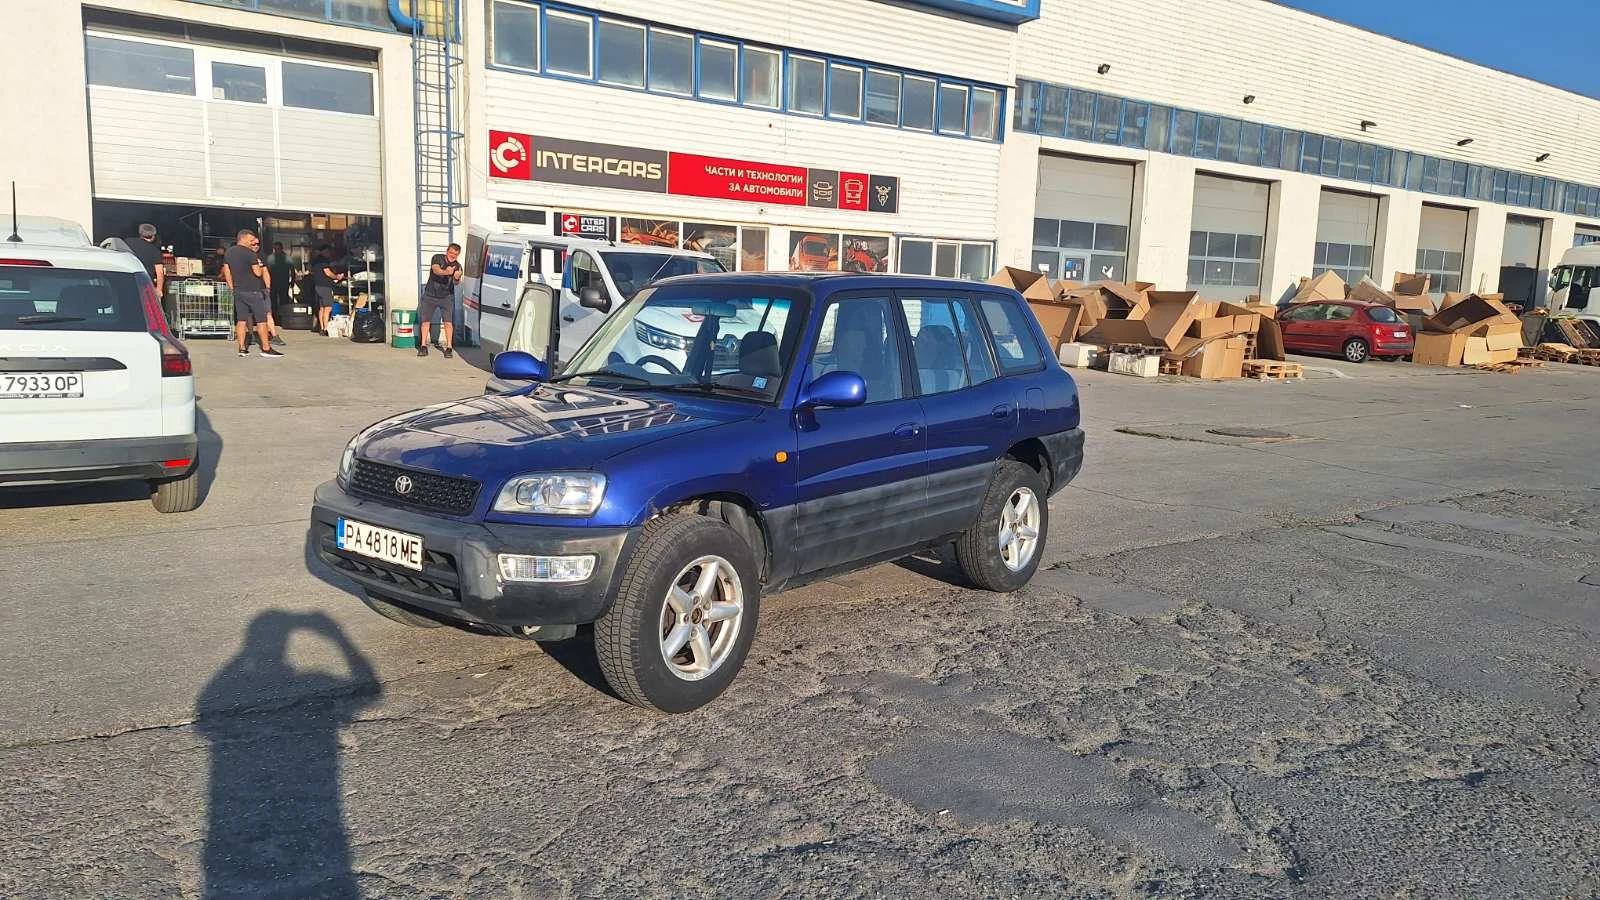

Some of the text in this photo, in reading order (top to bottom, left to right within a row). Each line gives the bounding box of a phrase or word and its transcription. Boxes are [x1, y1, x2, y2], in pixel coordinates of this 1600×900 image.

[536, 150, 662, 180] INTERCARS
[705, 165, 803, 184] ЧАСТИ И ТЕХНОЛОГИИ
[728, 182, 803, 198] ЗА АВТОМОБИЛИ
[581, 217, 605, 225] INTER
[4, 376, 51, 391] 7933
[346, 524, 419, 565] PA 4818 ME
